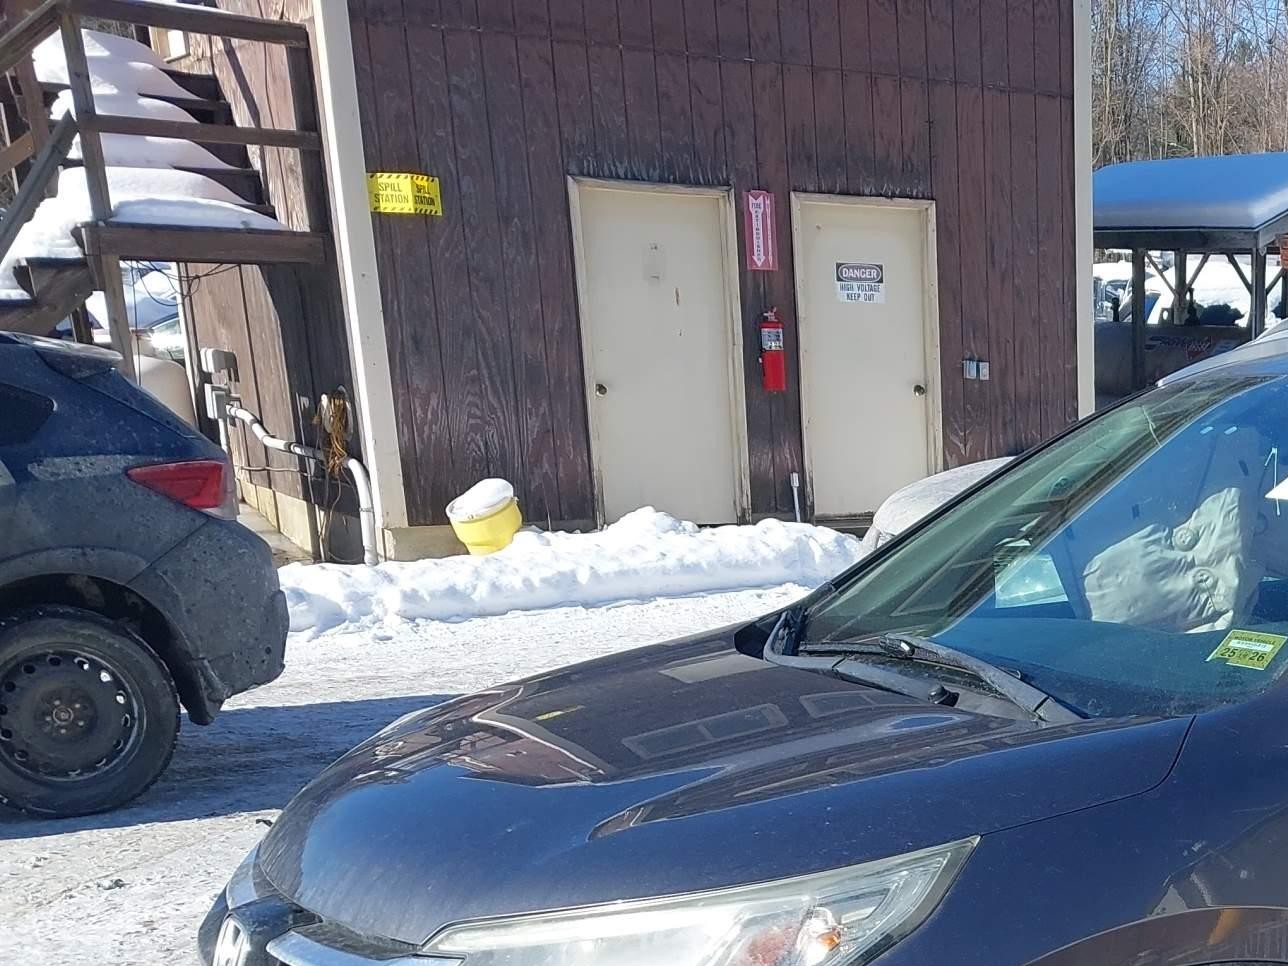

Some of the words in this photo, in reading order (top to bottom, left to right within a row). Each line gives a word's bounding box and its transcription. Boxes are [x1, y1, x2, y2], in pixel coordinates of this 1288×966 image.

[378, 182, 403, 192] SPILL
[416, 184, 430, 194] SPILL
[374, 193, 409, 204] STATION
[414, 194, 435, 206] STATION
[842, 267, 878, 279] DANGER
[840, 283, 855, 291] HIGH
[856, 283, 880, 293] VOLTAGE
[846, 292, 860, 301] KEEP
[863, 293, 875, 301] OUT
[1220, 647, 1239, 658] 25
[1249, 651, 1267, 662] 26
